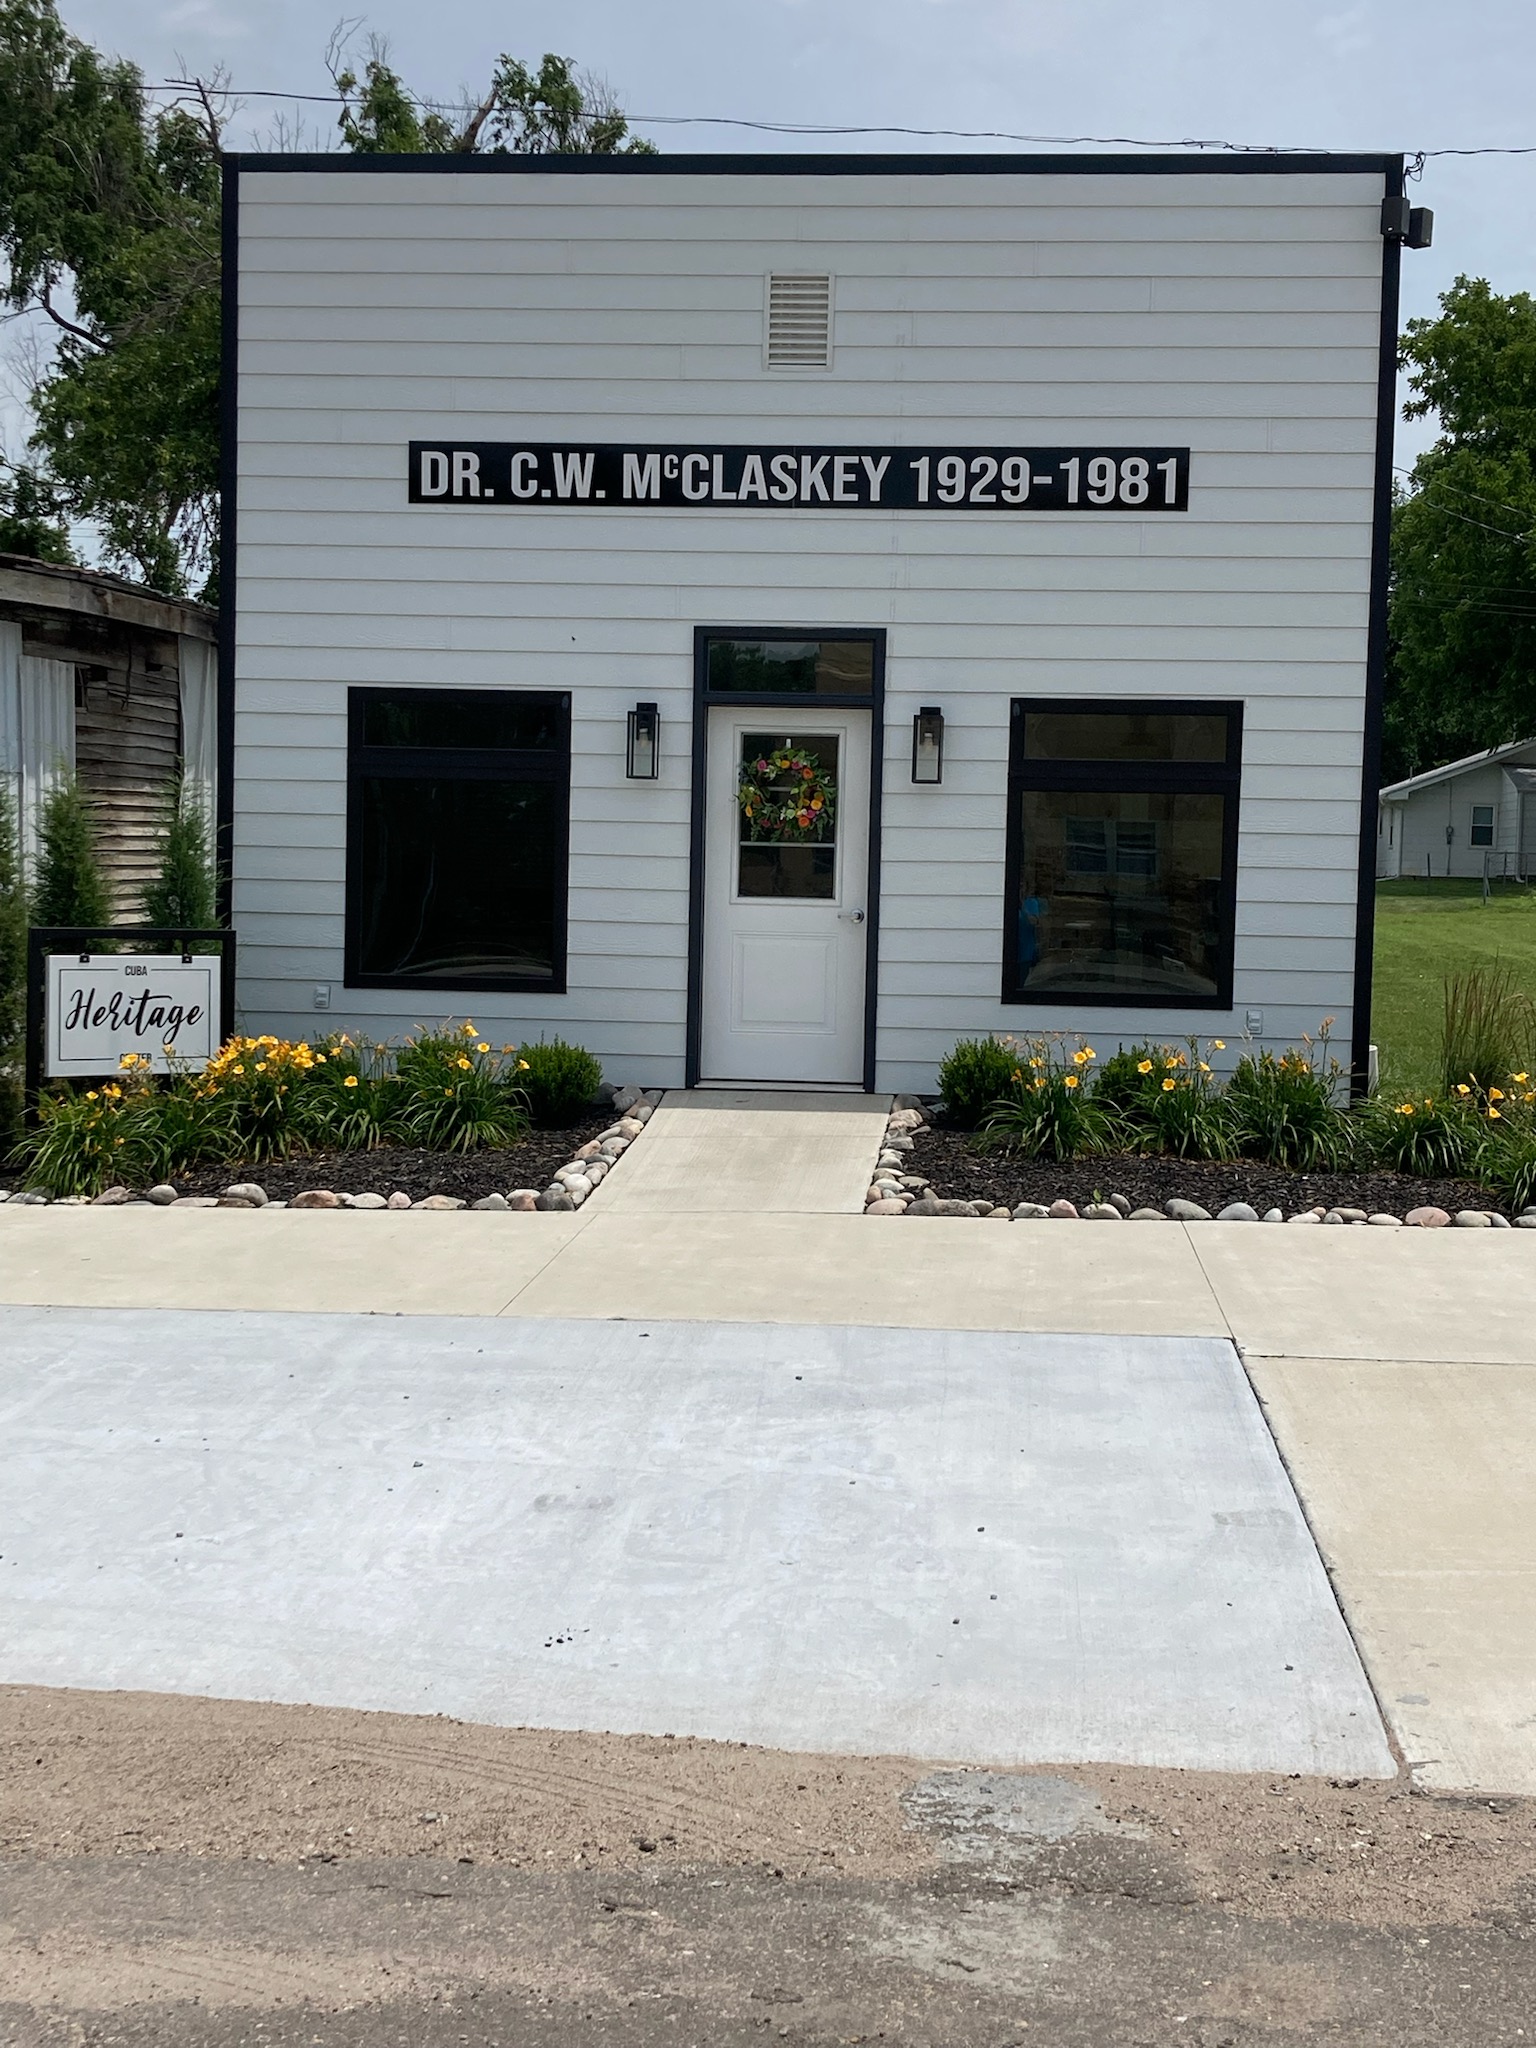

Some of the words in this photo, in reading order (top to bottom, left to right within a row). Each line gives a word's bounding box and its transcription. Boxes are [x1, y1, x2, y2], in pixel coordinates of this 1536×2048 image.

[422, 452, 494, 497] DR.
[512, 452, 606, 498] C.W.
[910, 457, 1177, 503] 1929-1981
[125, 965, 148, 976] CUBA
[65, 987, 204, 1045] Heritage
